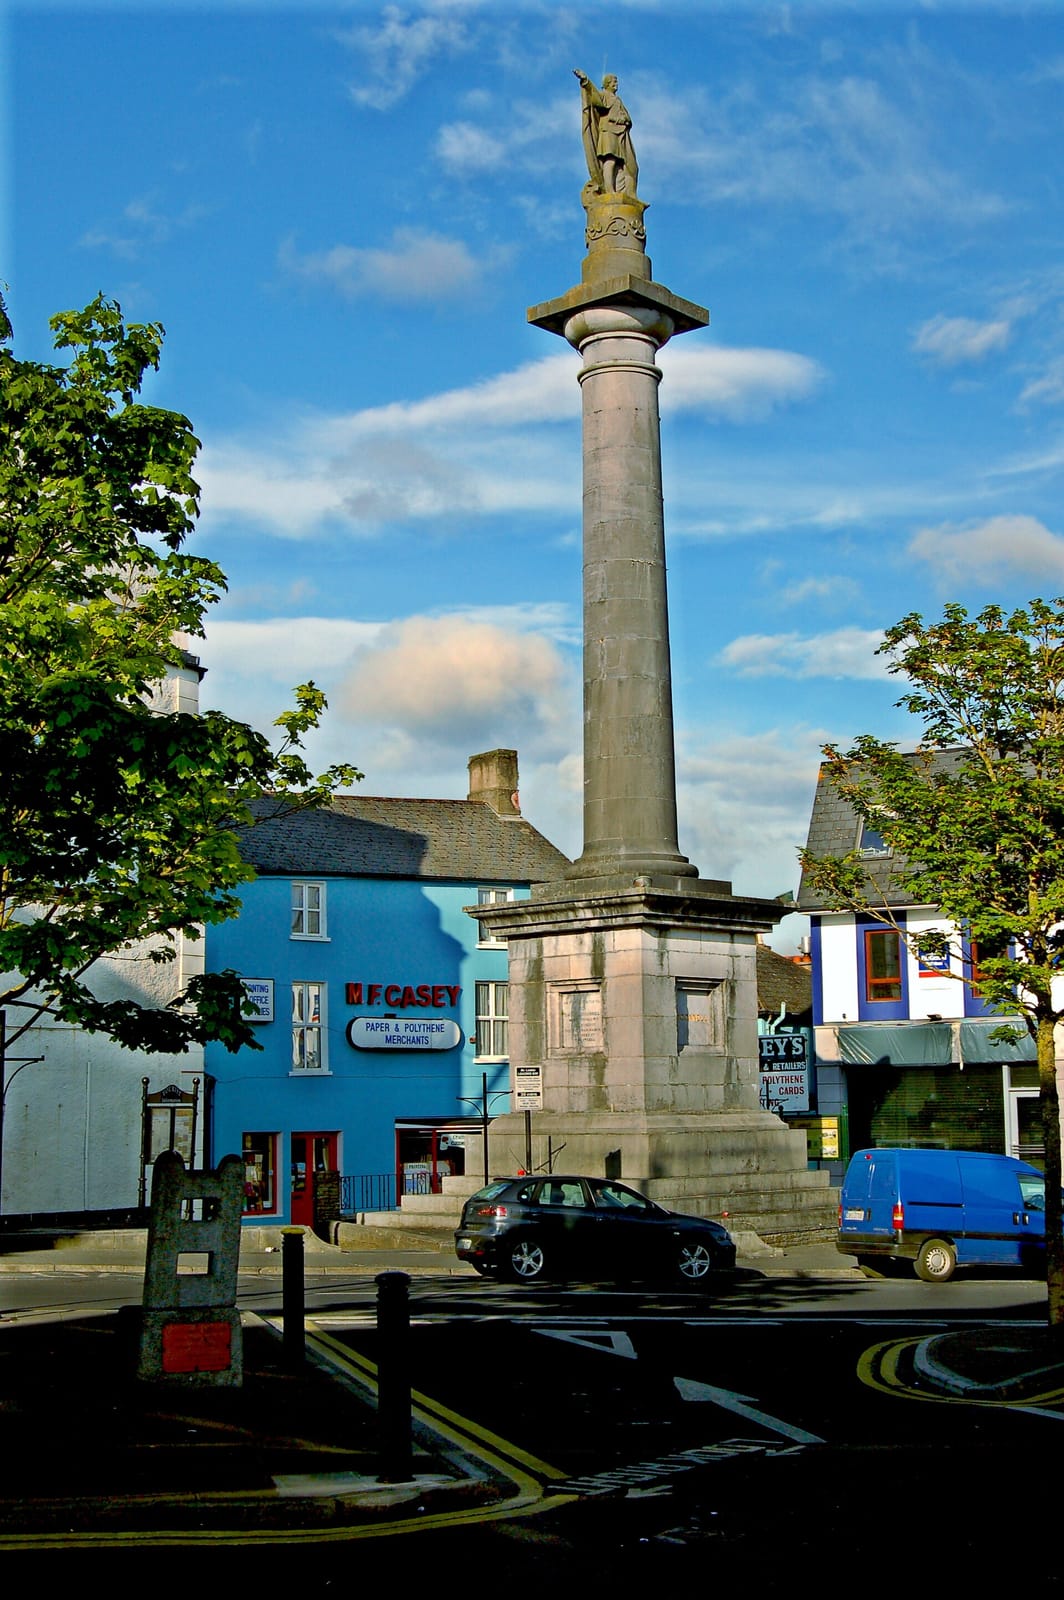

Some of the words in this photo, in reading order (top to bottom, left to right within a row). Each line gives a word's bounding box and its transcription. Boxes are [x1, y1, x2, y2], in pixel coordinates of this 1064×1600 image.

[385, 984, 461, 1008] CASEY
[365, 1022, 390, 1032] PAPER
[394, 1023, 400, 1032] &
[404, 1023, 445, 1032] POLYTHENE
[385, 1035, 429, 1044] MERCHANTS
[772, 1062, 806, 1070] RETAILERS
[762, 1075, 804, 1085] POLYTHENE
[779, 1086, 805, 1095] CARDS
